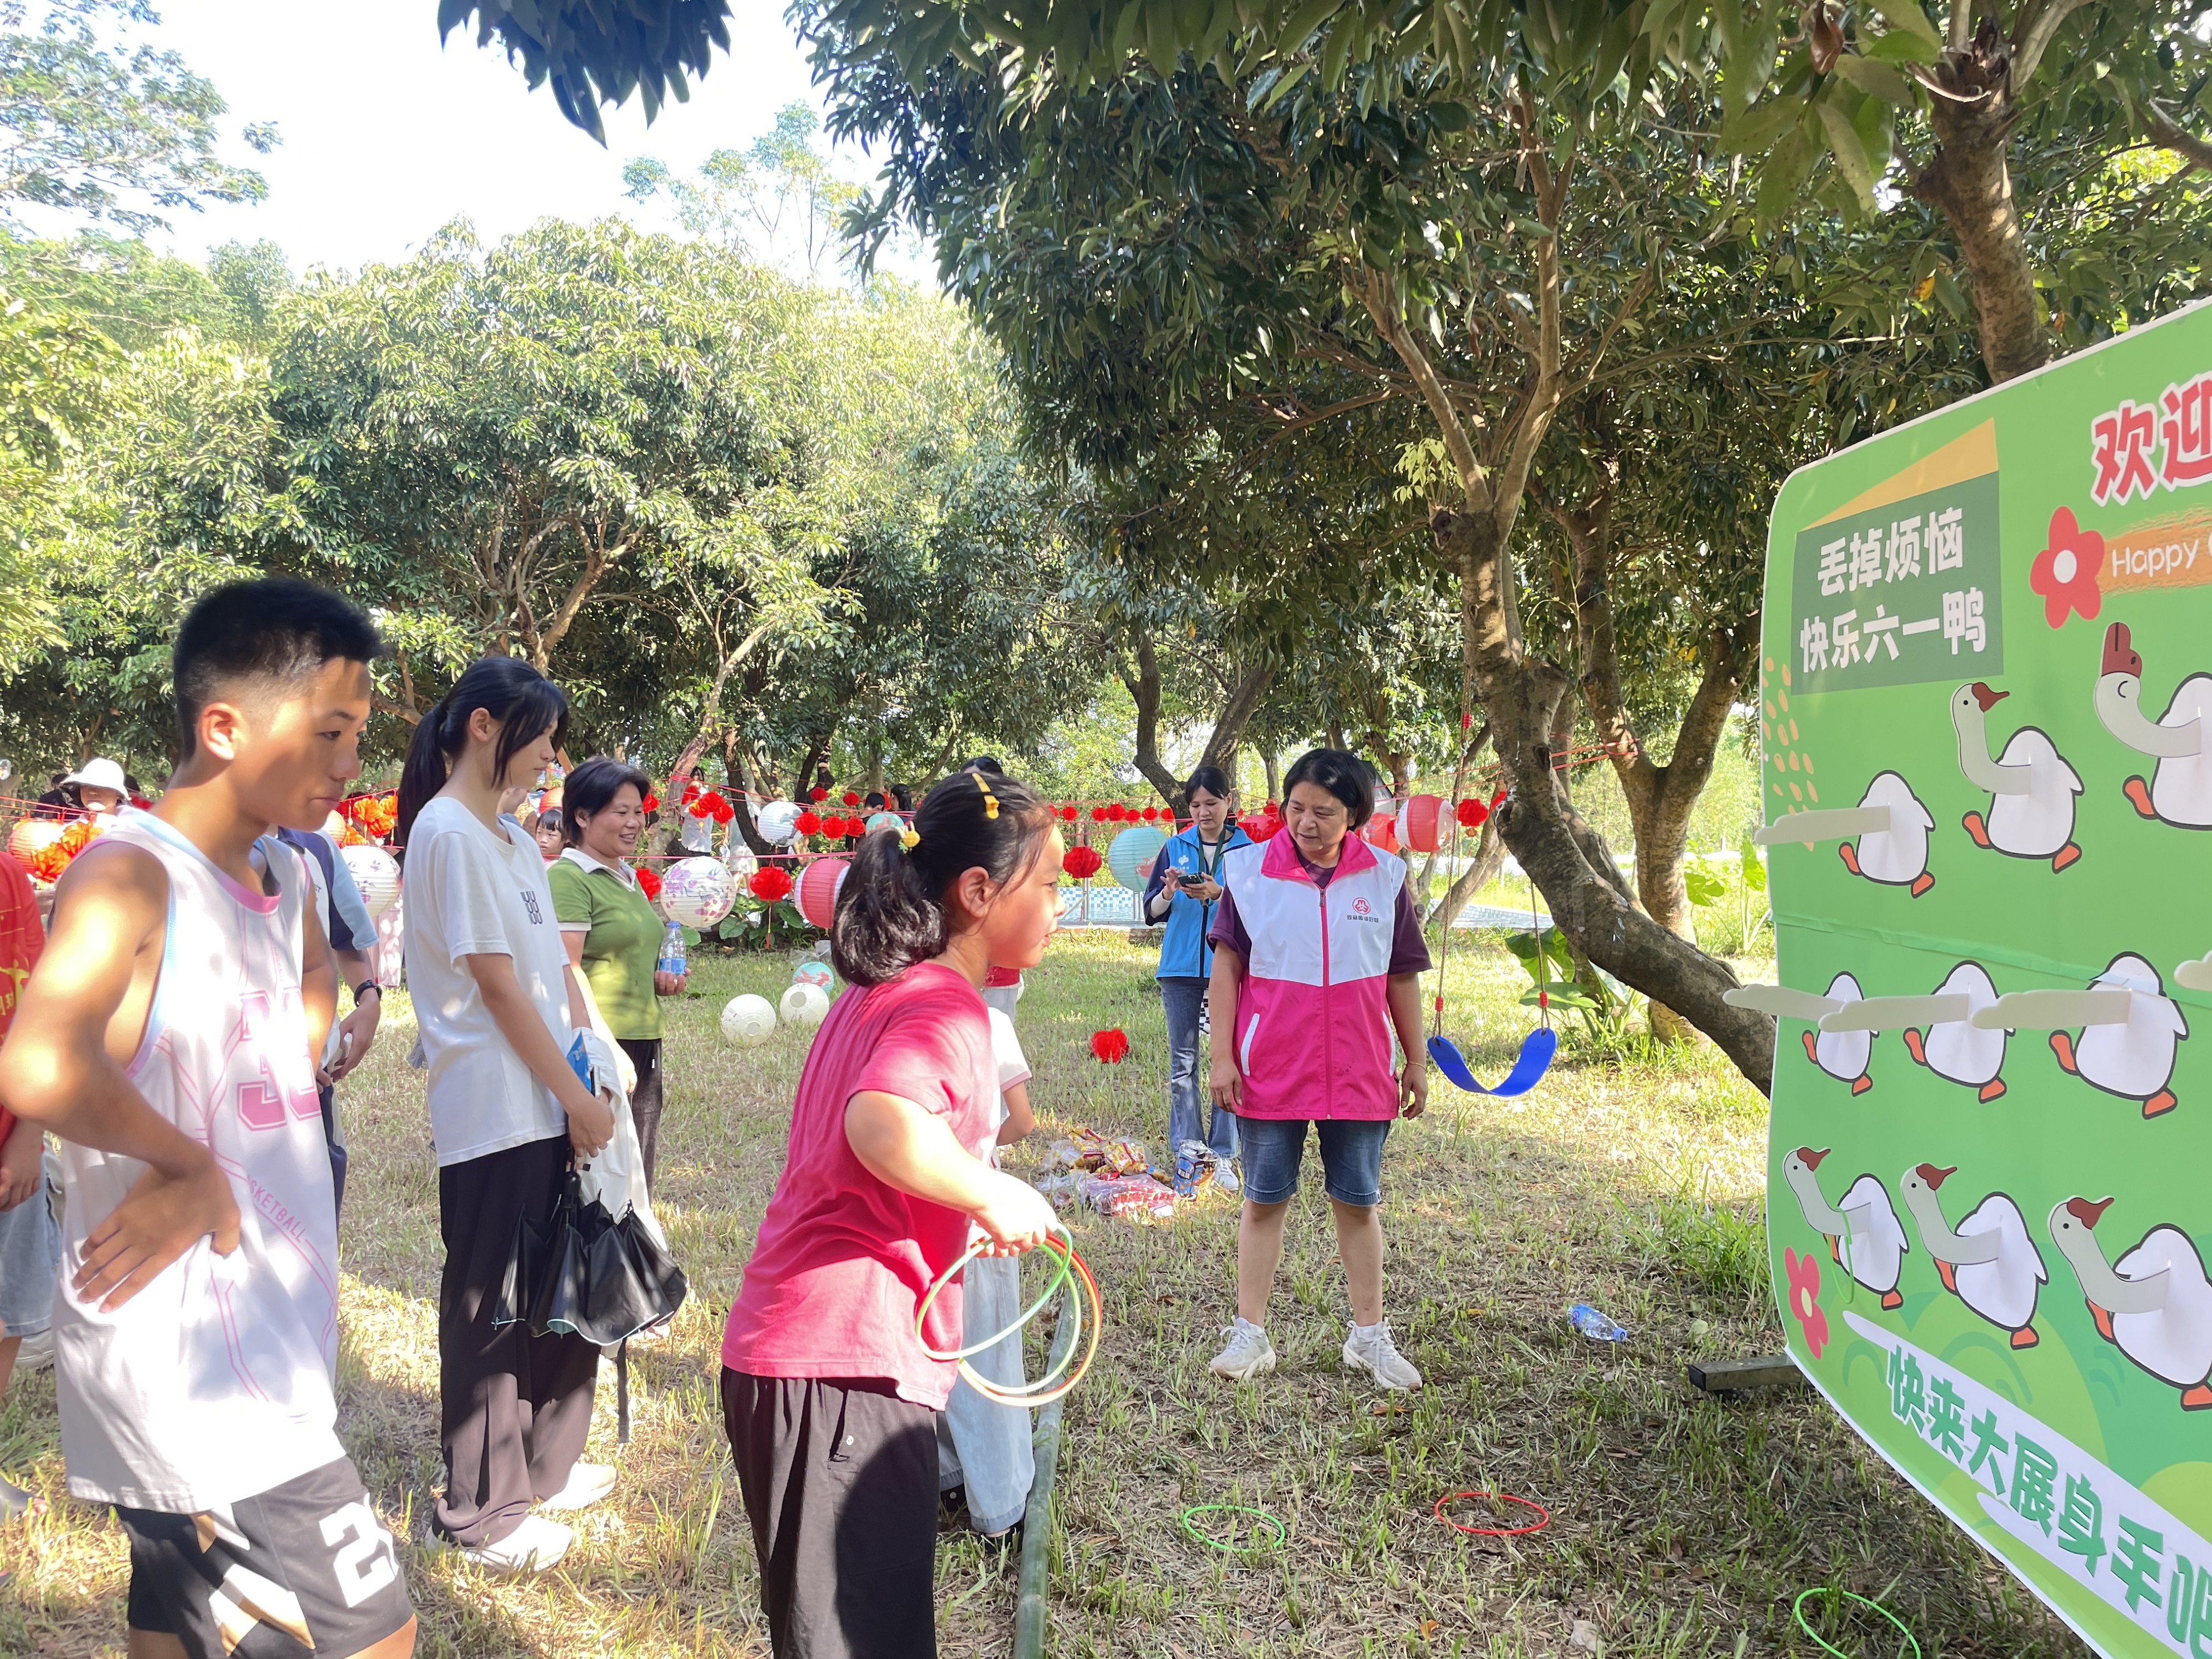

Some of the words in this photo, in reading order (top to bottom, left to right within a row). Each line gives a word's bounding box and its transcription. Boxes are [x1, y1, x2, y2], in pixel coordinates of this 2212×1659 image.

[1817, 507, 1964, 596] 丢掉烦恼
[2112, 539, 2199, 578] Happy
[1800, 586, 1986, 673] 快乐六一鸭
[248, 1174, 306, 1243] SKETBALL
